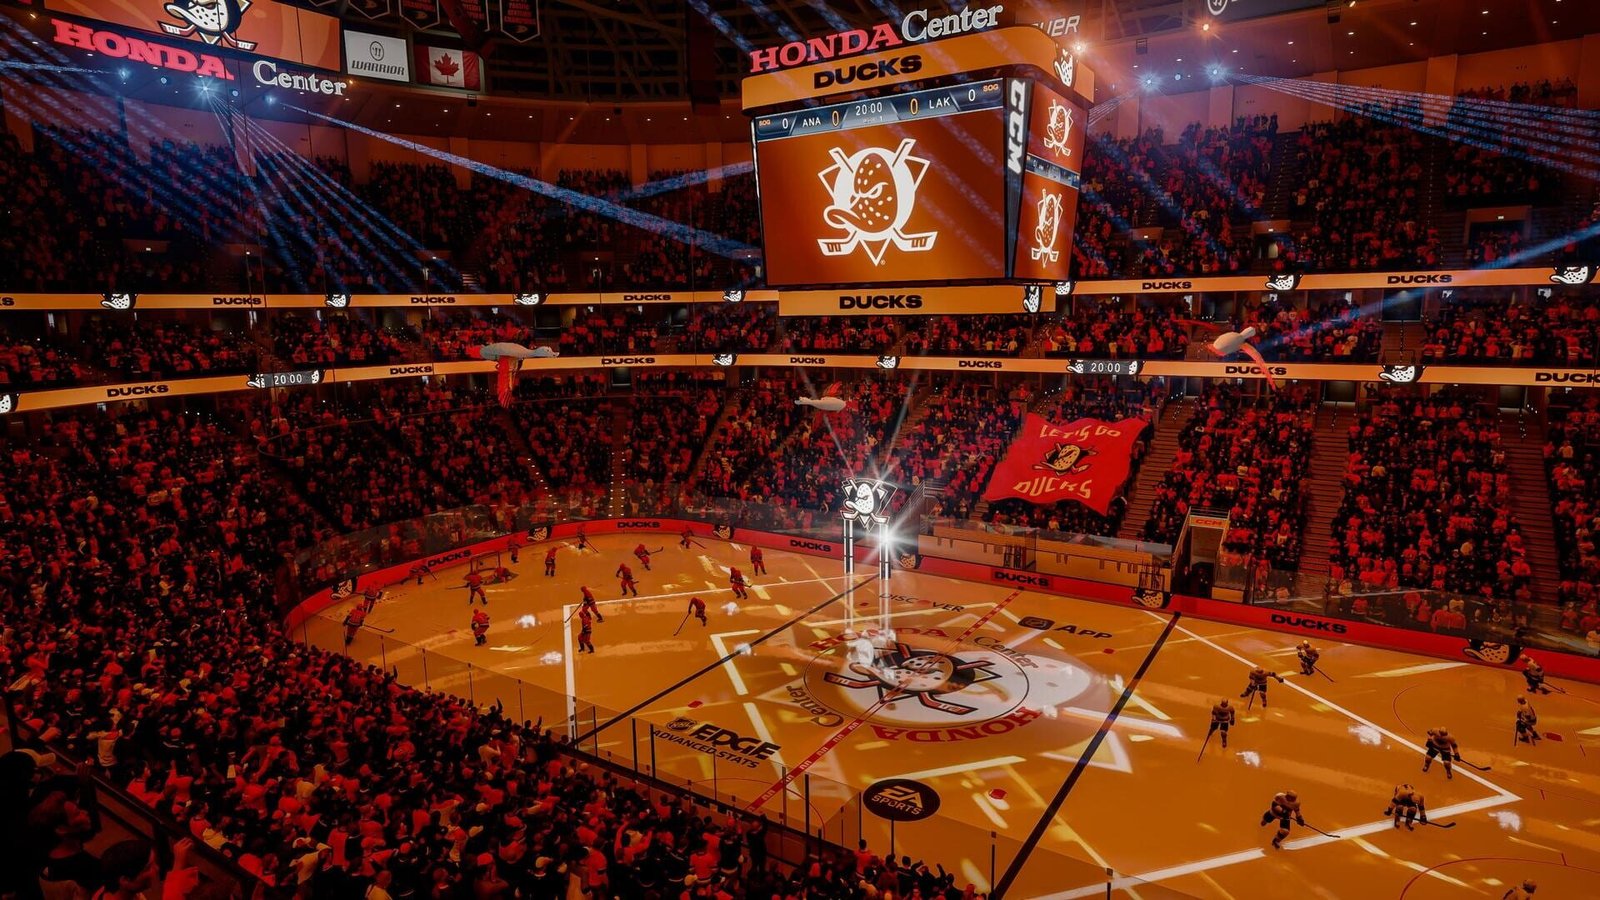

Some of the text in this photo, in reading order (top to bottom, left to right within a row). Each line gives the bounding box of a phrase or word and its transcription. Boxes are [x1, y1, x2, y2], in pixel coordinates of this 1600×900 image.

[750, 5, 1003, 73] HONDA Center
[51, 18, 347, 96] HONDA Center
[351, 60, 405, 76] WARRIOR
[814, 55, 923, 89] DUCKS
[782, 118, 789, 130] 0
[802, 118, 821, 128] ANA
[832, 110, 840, 127] 0
[855, 102, 883, 116] 20:00
[910, 98, 919, 115] 0
[929, 97, 951, 109] LAK
[968, 89, 976, 101] 0
[983, 83, 999, 92] SOG
[1008, 79, 1026, 174] CCM
[1142, 281, 1192, 290] DUCKS
[1387, 274, 1453, 284] DUCKS
[213, 297, 261, 305] DUCKS
[411, 296, 456, 304] DUCKS
[839, 294, 923, 310] DUCKS
[601, 357, 655, 365] DUCKS
[790, 356, 826, 364] DUCKS
[959, 360, 1002, 369] DUCKS
[1091, 362, 1121, 373] 20:00
[390, 365, 433, 375] DUCKS
[273, 373, 303, 385] 20:00
[107, 384, 169, 398] DUCKS
[1094, 425, 1122, 438] GO
[1013, 476, 1092, 499] DUCKS
[790, 539, 831, 552] DUCKS
[428, 550, 472, 568] DUCKS
[994, 571, 1049, 588] DUCKS
[1271, 613, 1347, 634] DUCKS
[1054, 625, 1113, 639] APP
[974, 636, 1039, 668] Center
[786, 685, 844, 727] Center
[870, 706, 1043, 742] HONDA
[653, 730, 760, 769] ADVANCED STATS
[689, 724, 781, 760] EDGE
[872, 795, 922, 815] SPORTS
[878, 786, 923, 808] EA
